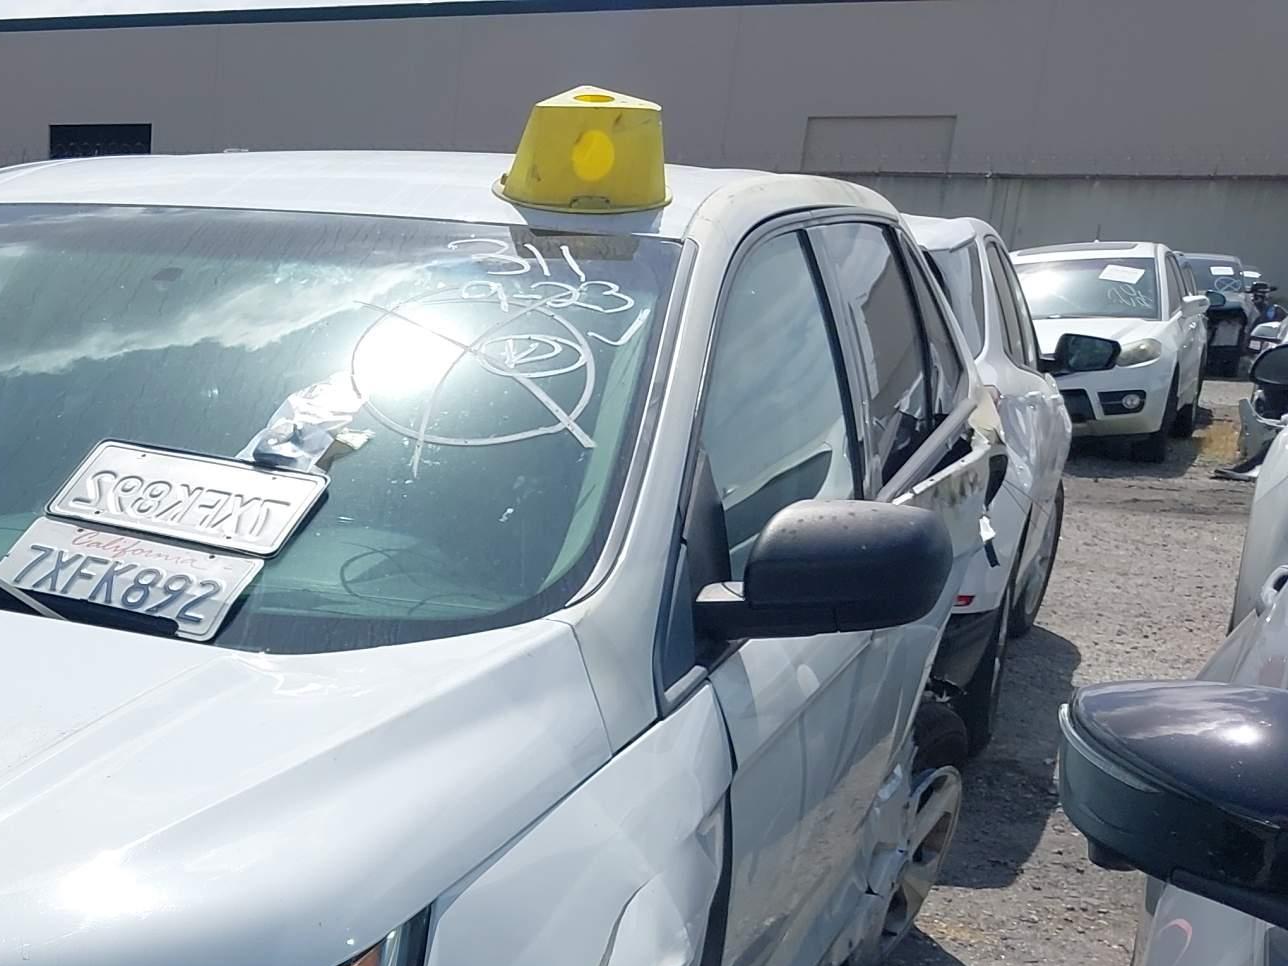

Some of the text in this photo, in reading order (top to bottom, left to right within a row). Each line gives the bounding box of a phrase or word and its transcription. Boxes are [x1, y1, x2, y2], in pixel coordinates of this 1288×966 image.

[447, 238, 586, 282] 311
[70, 530, 208, 570] California
[12, 544, 221, 624] 7XFK892
